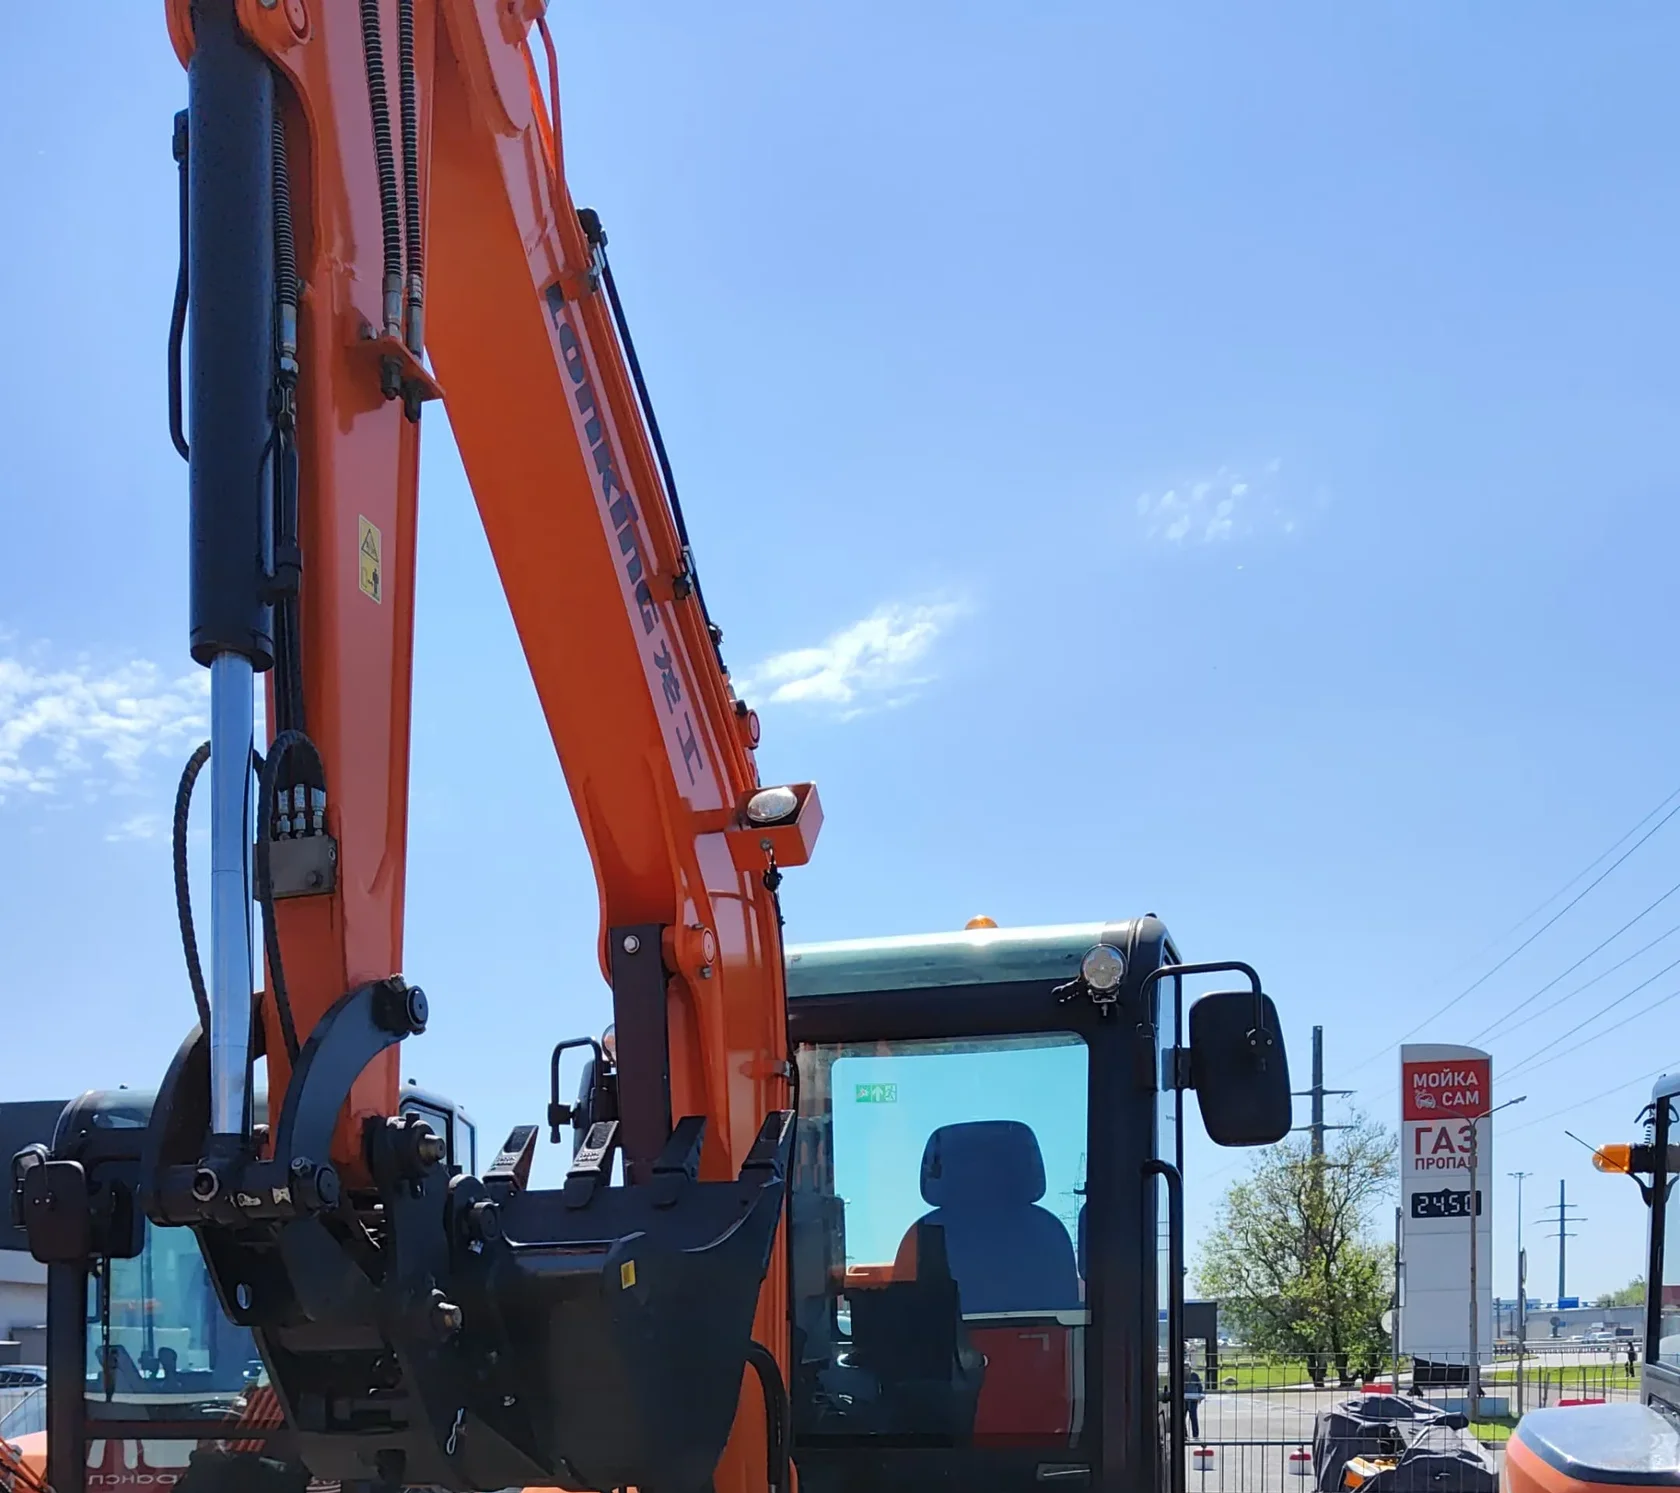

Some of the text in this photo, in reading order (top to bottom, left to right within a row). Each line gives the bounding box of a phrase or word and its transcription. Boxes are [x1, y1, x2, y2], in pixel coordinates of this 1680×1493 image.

[1413, 1068, 1479, 1088] МОЙКА
[1442, 1090, 1479, 1106] САМ
[1415, 1125, 1478, 1155] ГАЗ
